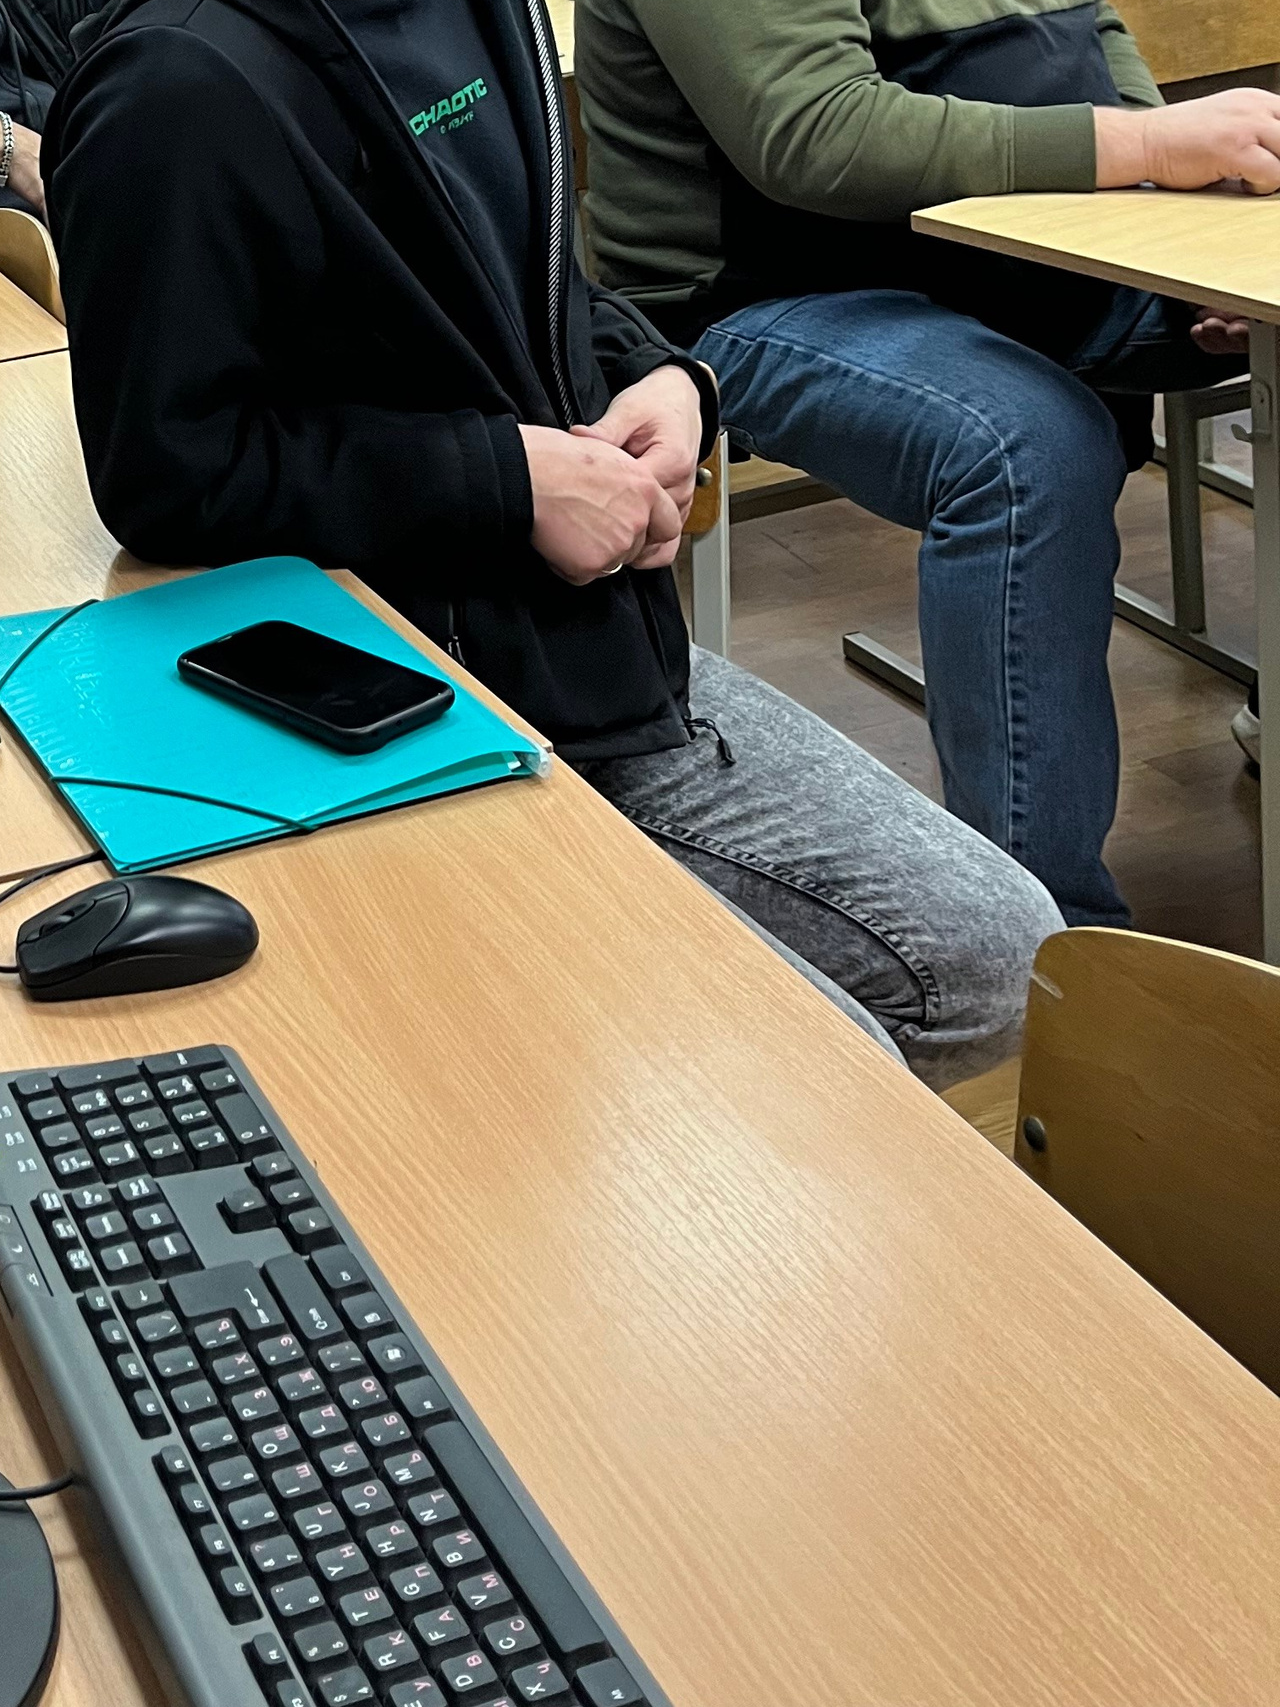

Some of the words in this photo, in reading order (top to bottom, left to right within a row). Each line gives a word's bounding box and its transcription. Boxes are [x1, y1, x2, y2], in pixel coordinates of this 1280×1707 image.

[408, 77, 488, 136] CHAOTIC
[243, 1409, 257, 1417] P
[313, 1425, 325, 1434] L
[331, 1461, 347, 1472] K
[395, 1468, 412, 1481] M
[420, 1509, 437, 1521] N
[306, 1524, 322, 1535] U
[378, 1541, 395, 1553] H
[447, 1552, 462, 1563] B
[328, 1567, 343, 1576] Y
[404, 1583, 419, 1595] G
[471, 1595, 487, 1605] V
[352, 1612, 368, 1621] T
[428, 1632, 445, 1640] F
[499, 1637, 515, 1649] C
[379, 1653, 396, 1666] R
[456, 1675, 473, 1686] D
[526, 1683, 545, 1695] X
